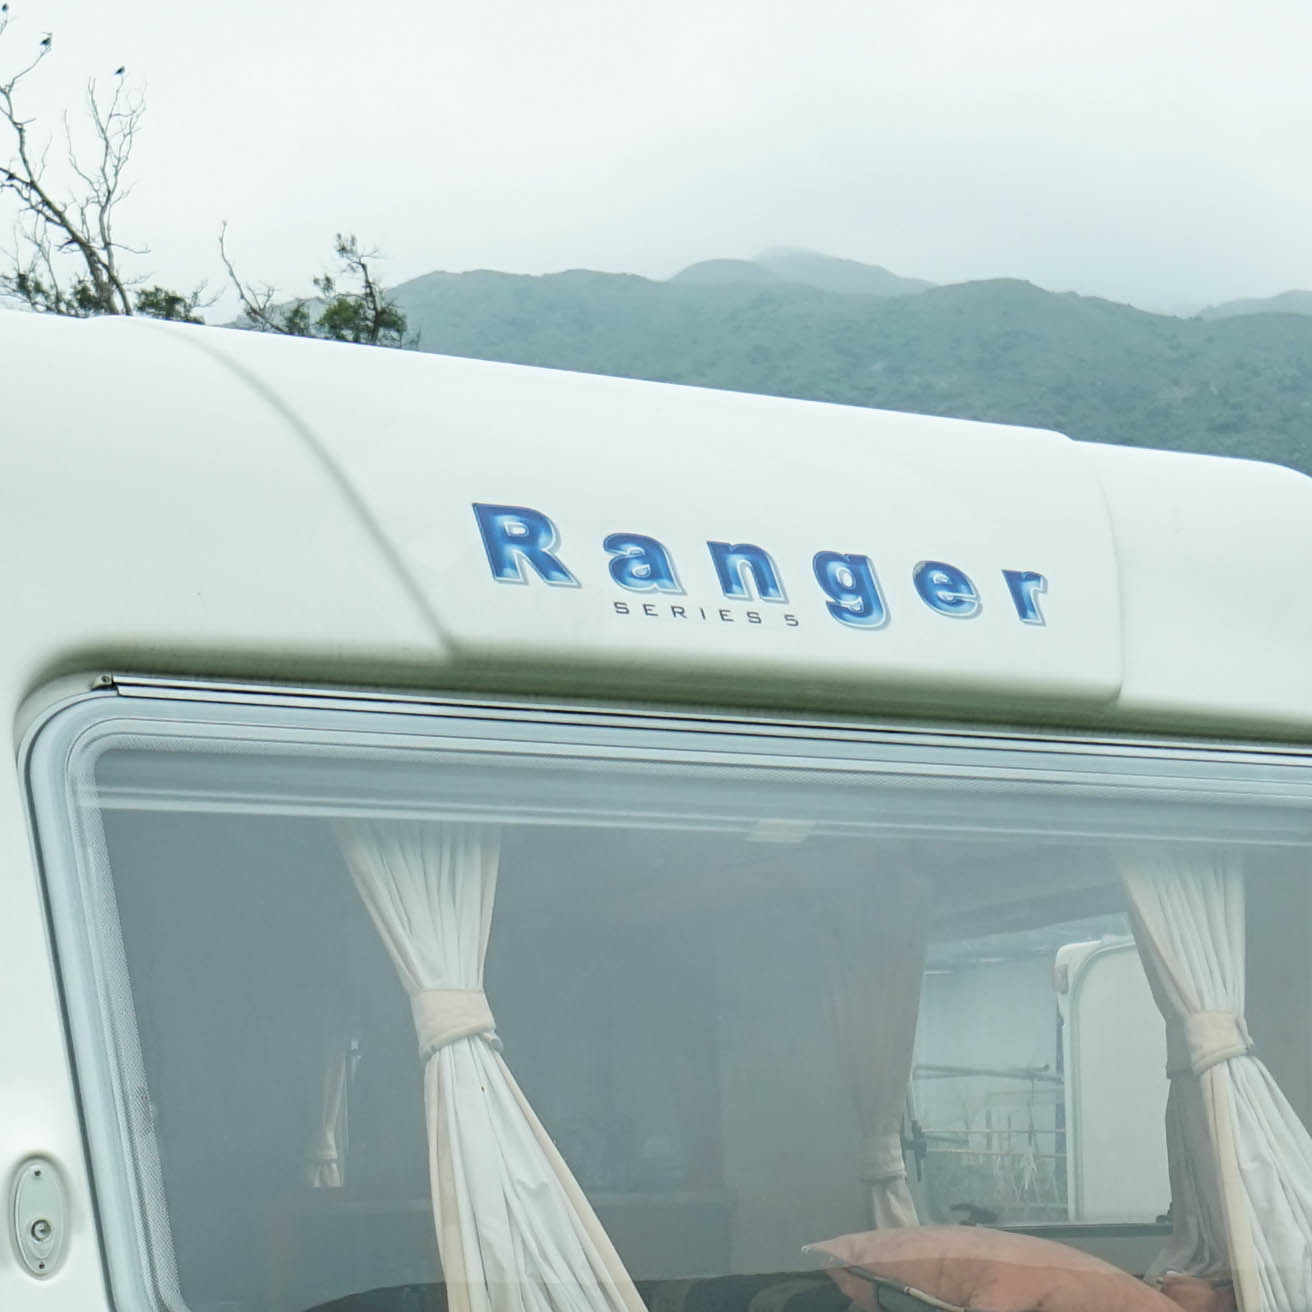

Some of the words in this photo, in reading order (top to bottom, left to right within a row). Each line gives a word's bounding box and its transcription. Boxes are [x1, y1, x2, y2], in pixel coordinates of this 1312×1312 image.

[471, 501, 1047, 631] Ranger
[613, 601, 762, 625] SERIES
[785, 613, 800, 628] 5
